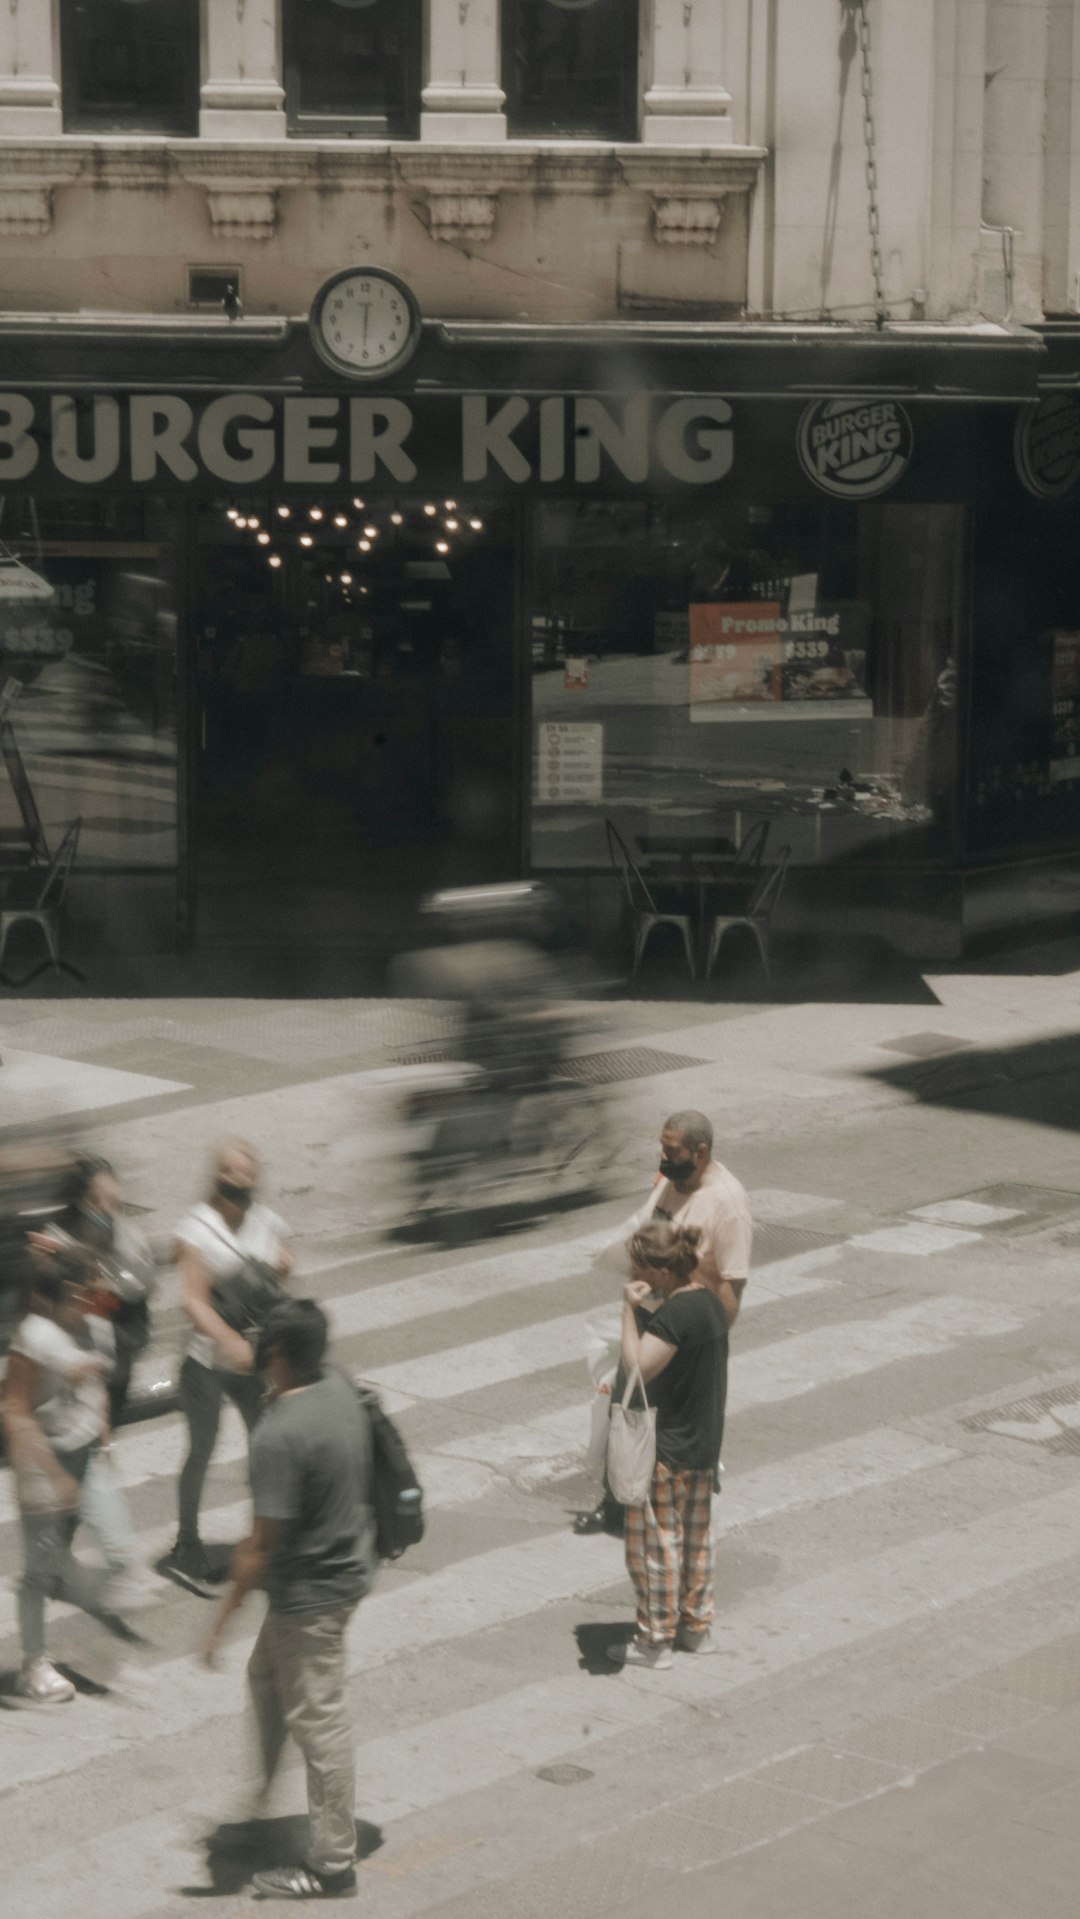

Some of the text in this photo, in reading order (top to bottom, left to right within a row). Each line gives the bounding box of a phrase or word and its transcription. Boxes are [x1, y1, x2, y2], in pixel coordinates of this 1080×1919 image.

[0, 393, 735, 485] BURGER KING
[812, 402, 896, 448] BURGER
[817, 421, 902, 474] KING
[721, 612, 840, 636] Promo King
[785, 640, 829, 659] $339
